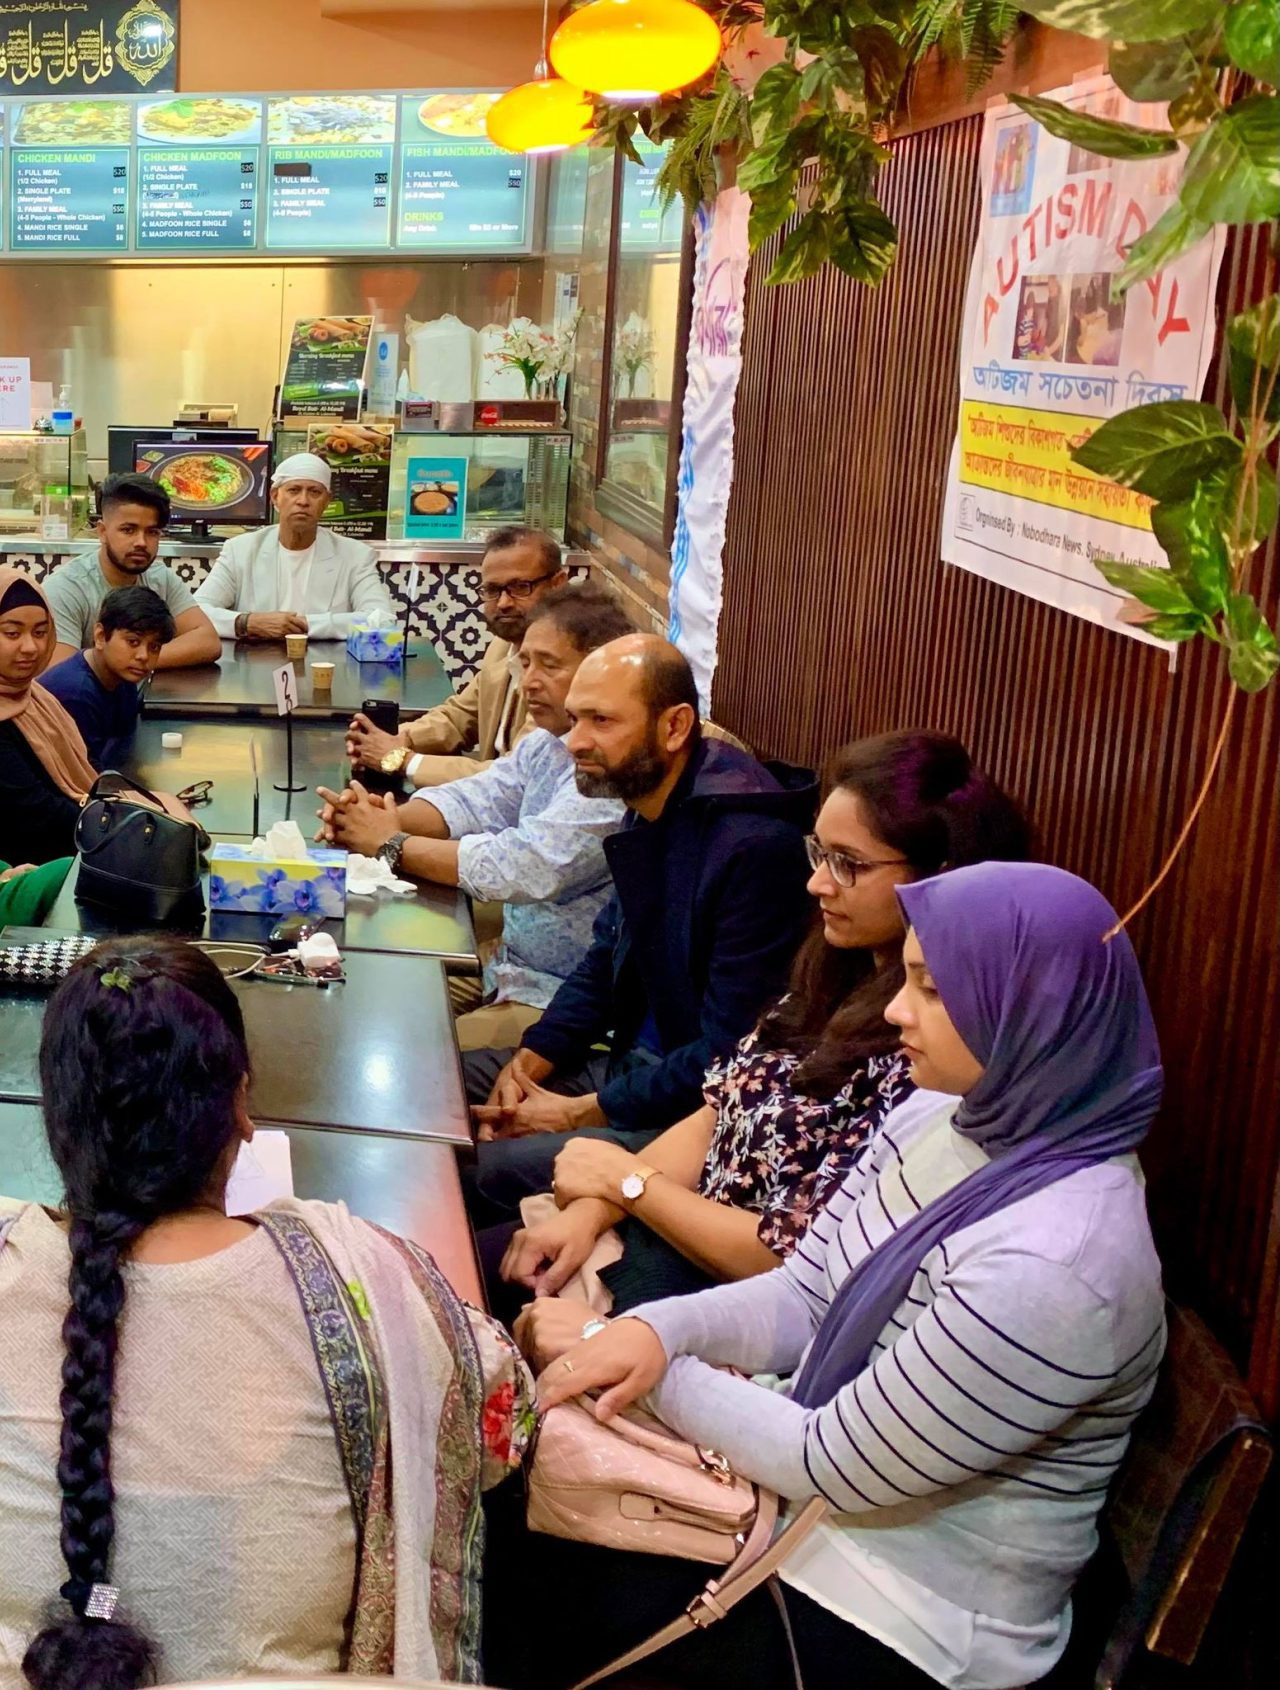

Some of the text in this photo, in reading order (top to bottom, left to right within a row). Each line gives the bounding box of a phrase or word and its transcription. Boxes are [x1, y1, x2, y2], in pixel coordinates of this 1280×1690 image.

[144, 152, 241, 162] CHICKEN MADFOON
[275, 151, 292, 159] RIB
[407, 148, 430, 156] FISH
[18, 154, 96, 163] CHICKEN MANDI
[404, 212, 444, 221] DRINKS
[984, 179, 1112, 349] AUTISM
[973, 360, 1033, 398] অটিজম
[1039, 370, 1119, 408] সচেতনা
[1006, 512, 1015, 538] By
[1022, 522, 1061, 548] Nobodhara
[281, 670, 291, 700] 2
